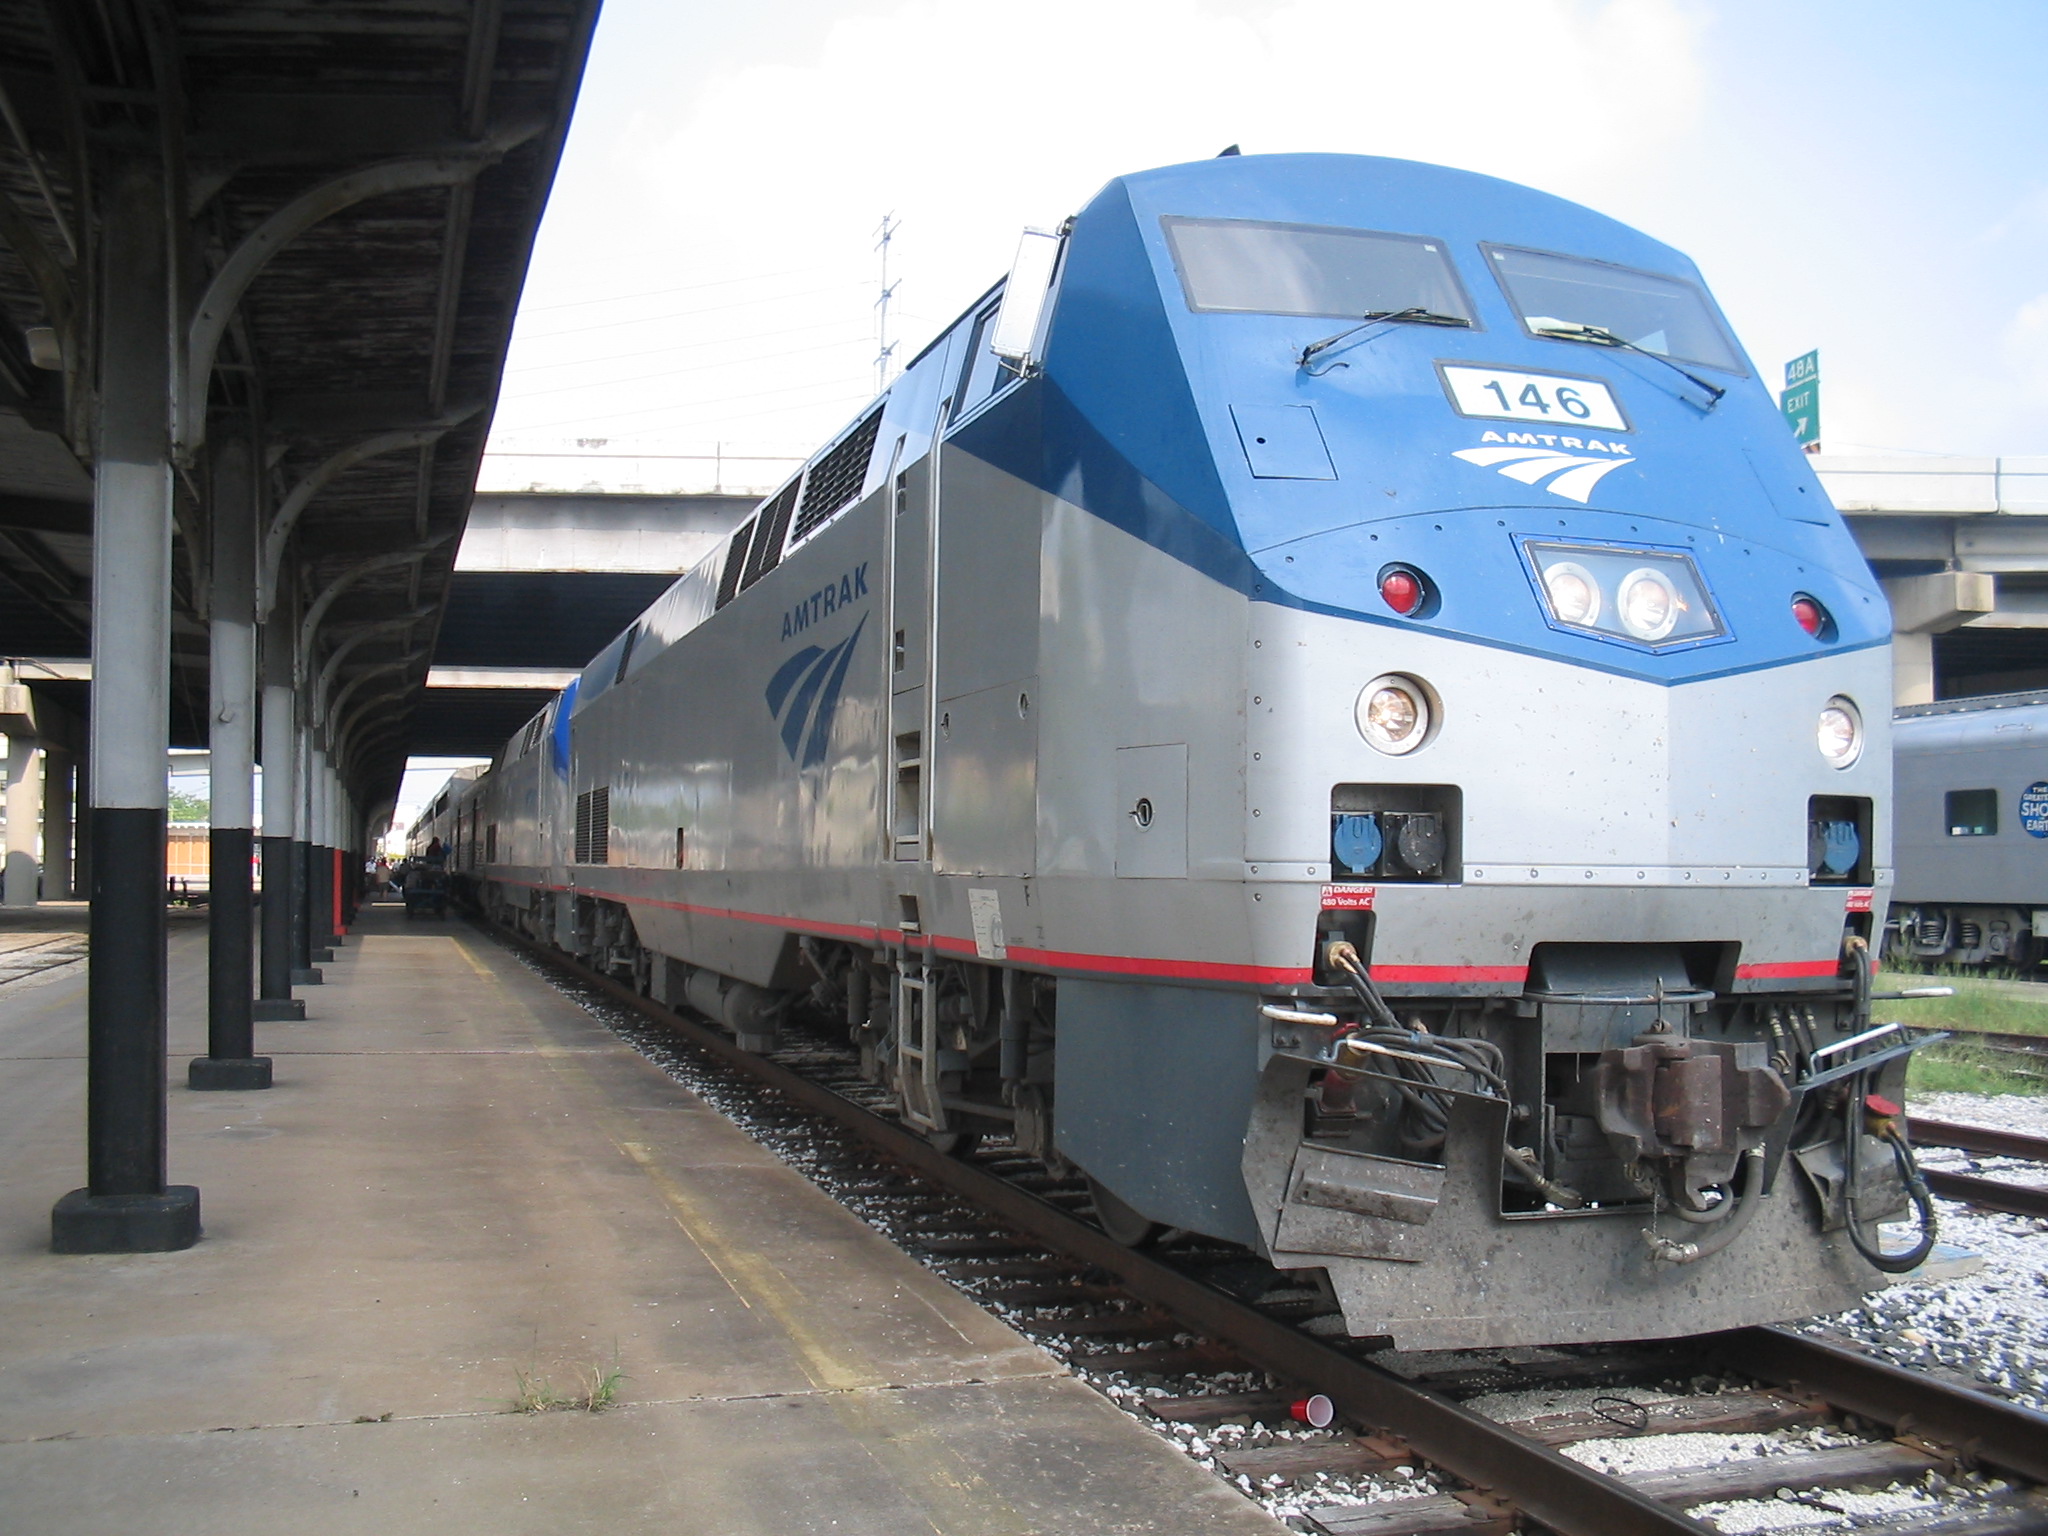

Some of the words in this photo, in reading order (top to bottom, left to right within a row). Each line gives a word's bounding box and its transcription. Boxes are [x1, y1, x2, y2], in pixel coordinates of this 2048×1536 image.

[1787, 356, 1815, 380] 48A
[1483, 380, 1591, 419] 146
[1787, 391, 1811, 413] EXIT
[1481, 430, 1632, 456] AMTRAK
[780, 561, 869, 642] AMTRAK
[1336, 897, 1357, 906] Volts
[1358, 897, 1371, 906] AC
